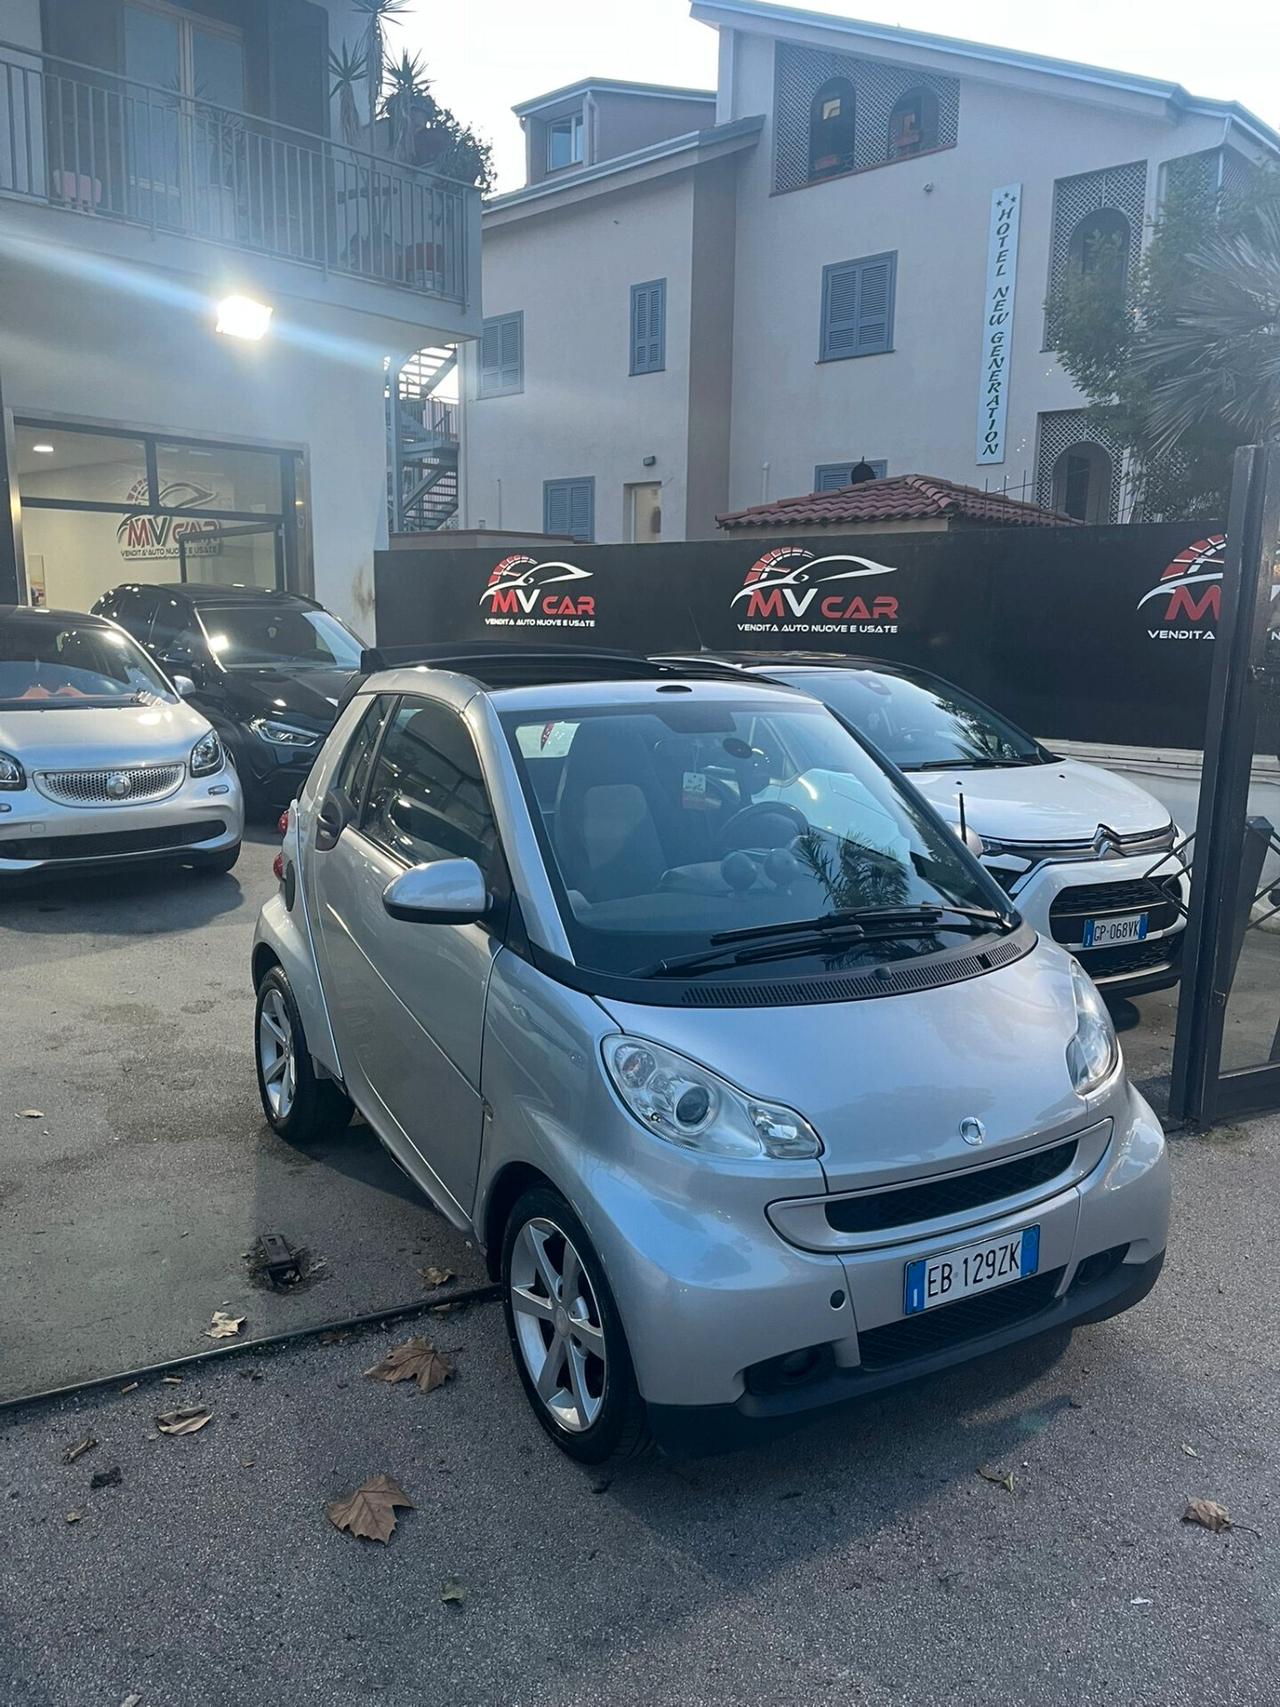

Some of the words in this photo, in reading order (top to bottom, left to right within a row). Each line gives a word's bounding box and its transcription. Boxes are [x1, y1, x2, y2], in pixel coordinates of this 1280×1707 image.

[995, 206, 1014, 277] HOTEL
[989, 285, 1010, 327] NEW
[982, 331, 1005, 456] GENERATION
[127, 515, 169, 547] MV
[491, 589, 541, 613] MV
[542, 596, 595, 615] CAR
[746, 588, 819, 618] MV
[820, 596, 899, 619] CAR
[1163, 584, 1222, 621] M
[485, 618, 514, 626] VENDITA
[515, 618, 536, 626] AUTO
[536, 619, 561, 627] NUOVE
[568, 619, 596, 628] USATE
[737, 623, 779, 632] VENDITA
[781, 624, 810, 632] AUTO
[811, 624, 848, 633] NUOVE
[849, 625, 857, 633] E
[859, 625, 898, 633] USATE
[1147, 629, 1216, 640] VENDITA
[927, 1262, 953, 1298] EB
[962, 1240, 1021, 1287] 129ZK
